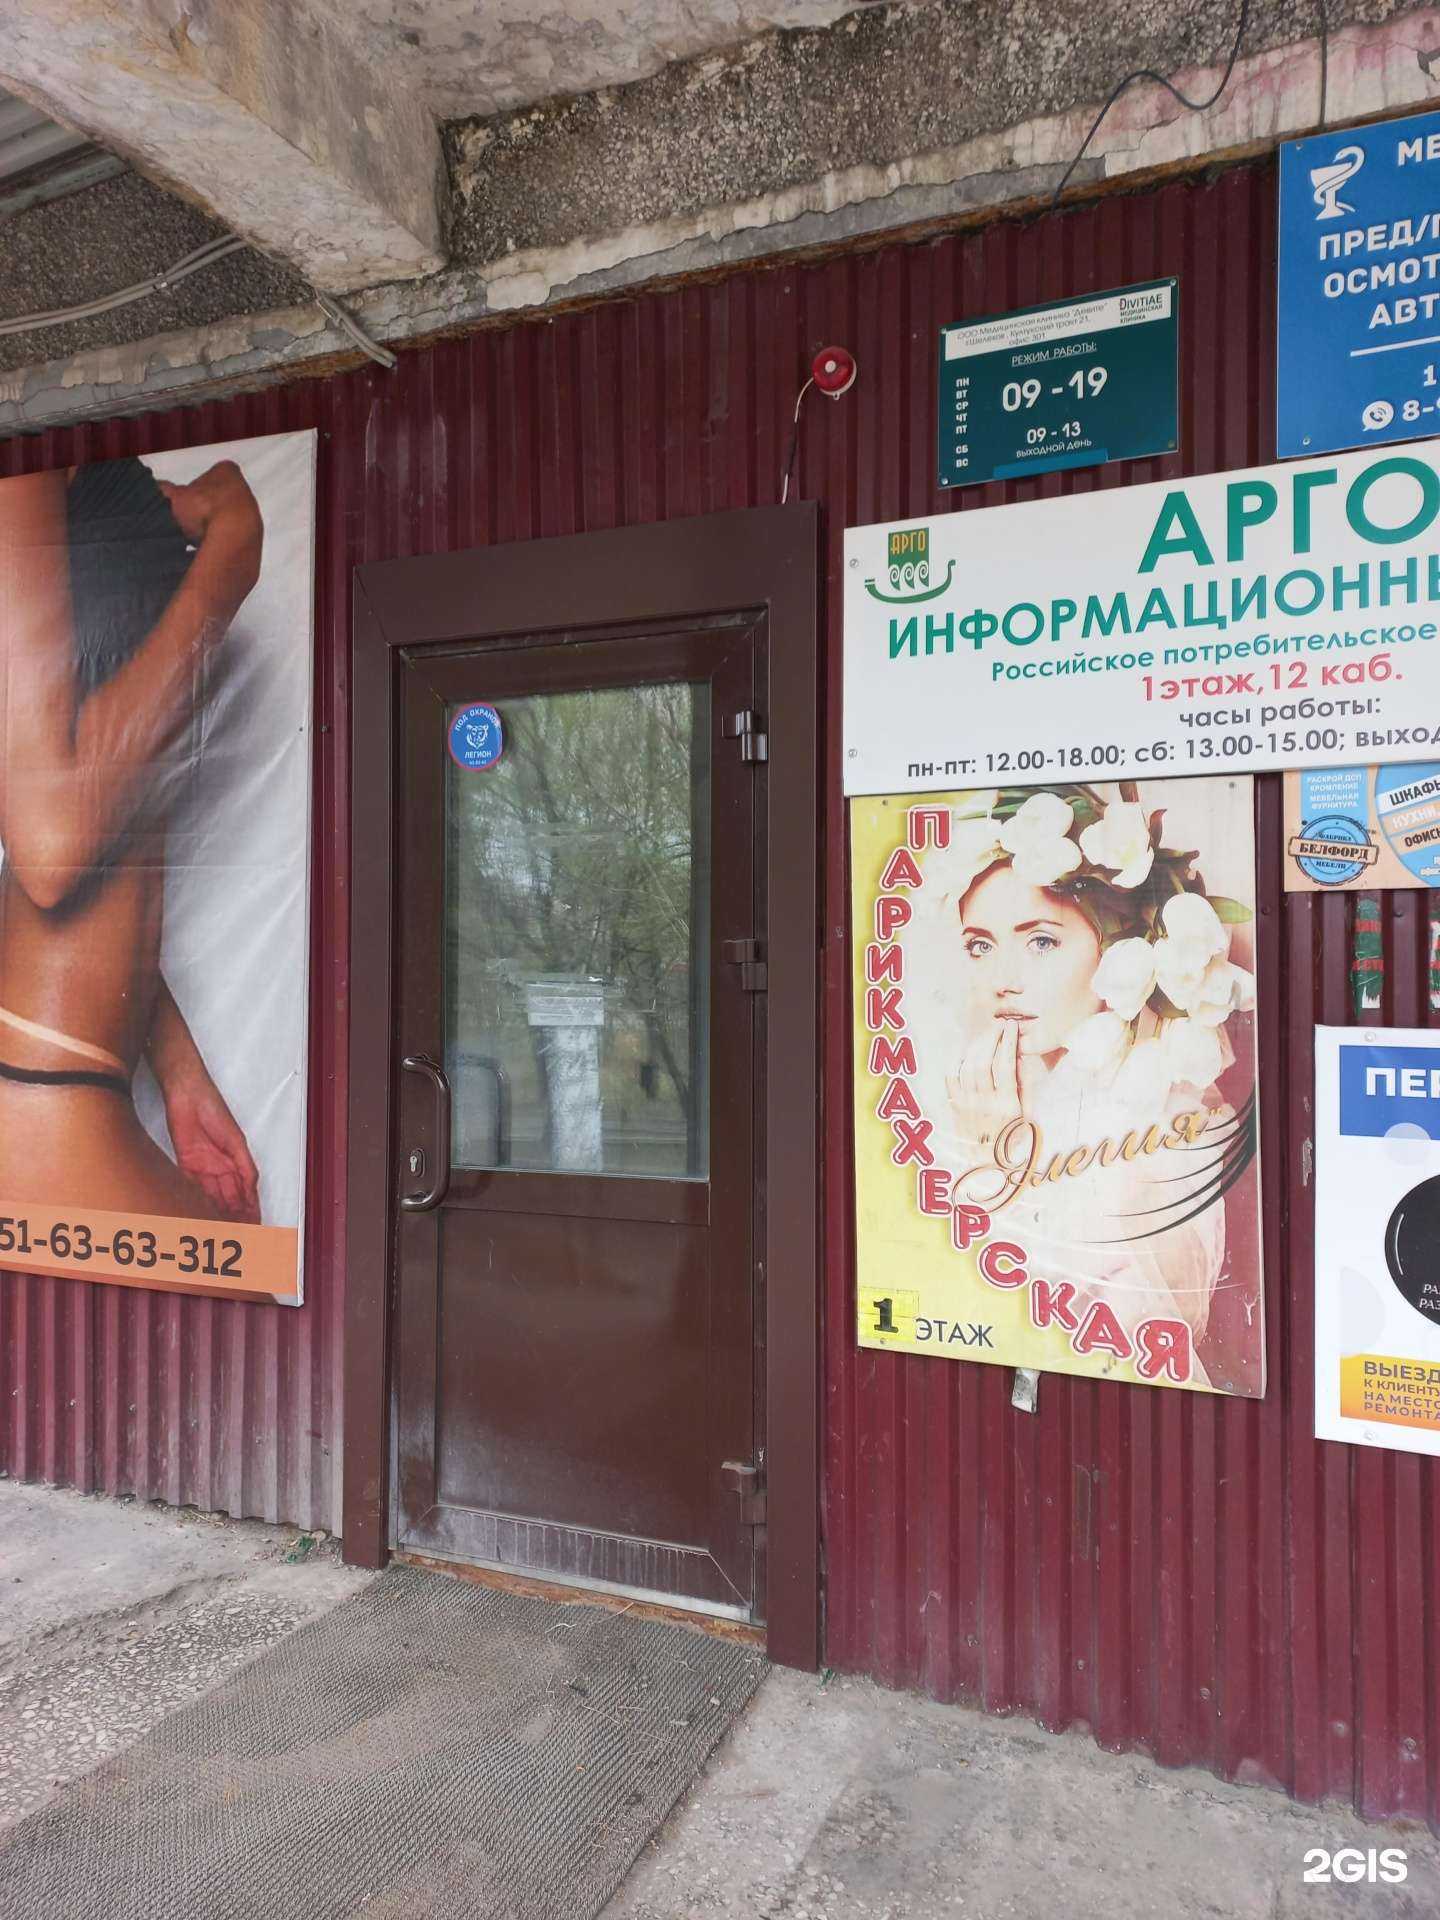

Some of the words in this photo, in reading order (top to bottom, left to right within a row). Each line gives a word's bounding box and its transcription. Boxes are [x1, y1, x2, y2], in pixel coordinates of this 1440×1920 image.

[1323, 253, 1440, 298] ОСМОТ
[1368, 293, 1440, 329] АВТ
[1011, 349, 1050, 367] РЕЖИМ
[1062, 421, 1081, 438] 13
[1138, 457, 1440, 574] АРГО
[891, 530, 926, 555] АРГО
[992, 651, 1154, 681] Российское
[1164, 622, 1439, 665] потребительское
[1321, 653, 1403, 686] каб.
[1179, 707, 1251, 728] часы
[1261, 697, 1381, 726] работы:
[907, 759, 977, 777] пн-пт:
[985, 744, 1126, 773] 12.00-18.00;
[1134, 741, 1175, 763] сб:
[1186, 729, 1345, 759] 13.00-15.00;
[1299, 842, 1369, 860] БЕЛФОРД
[1404, 827, 1440, 847] ОФИС
[866, 809, 1192, 1383] ПАРИКМАХЕРСКАЯ
[873, 1298, 899, 1333] 1
[915, 1317, 994, 1348] ЭТАЖ
[1364, 1378, 1373, 1388] К
